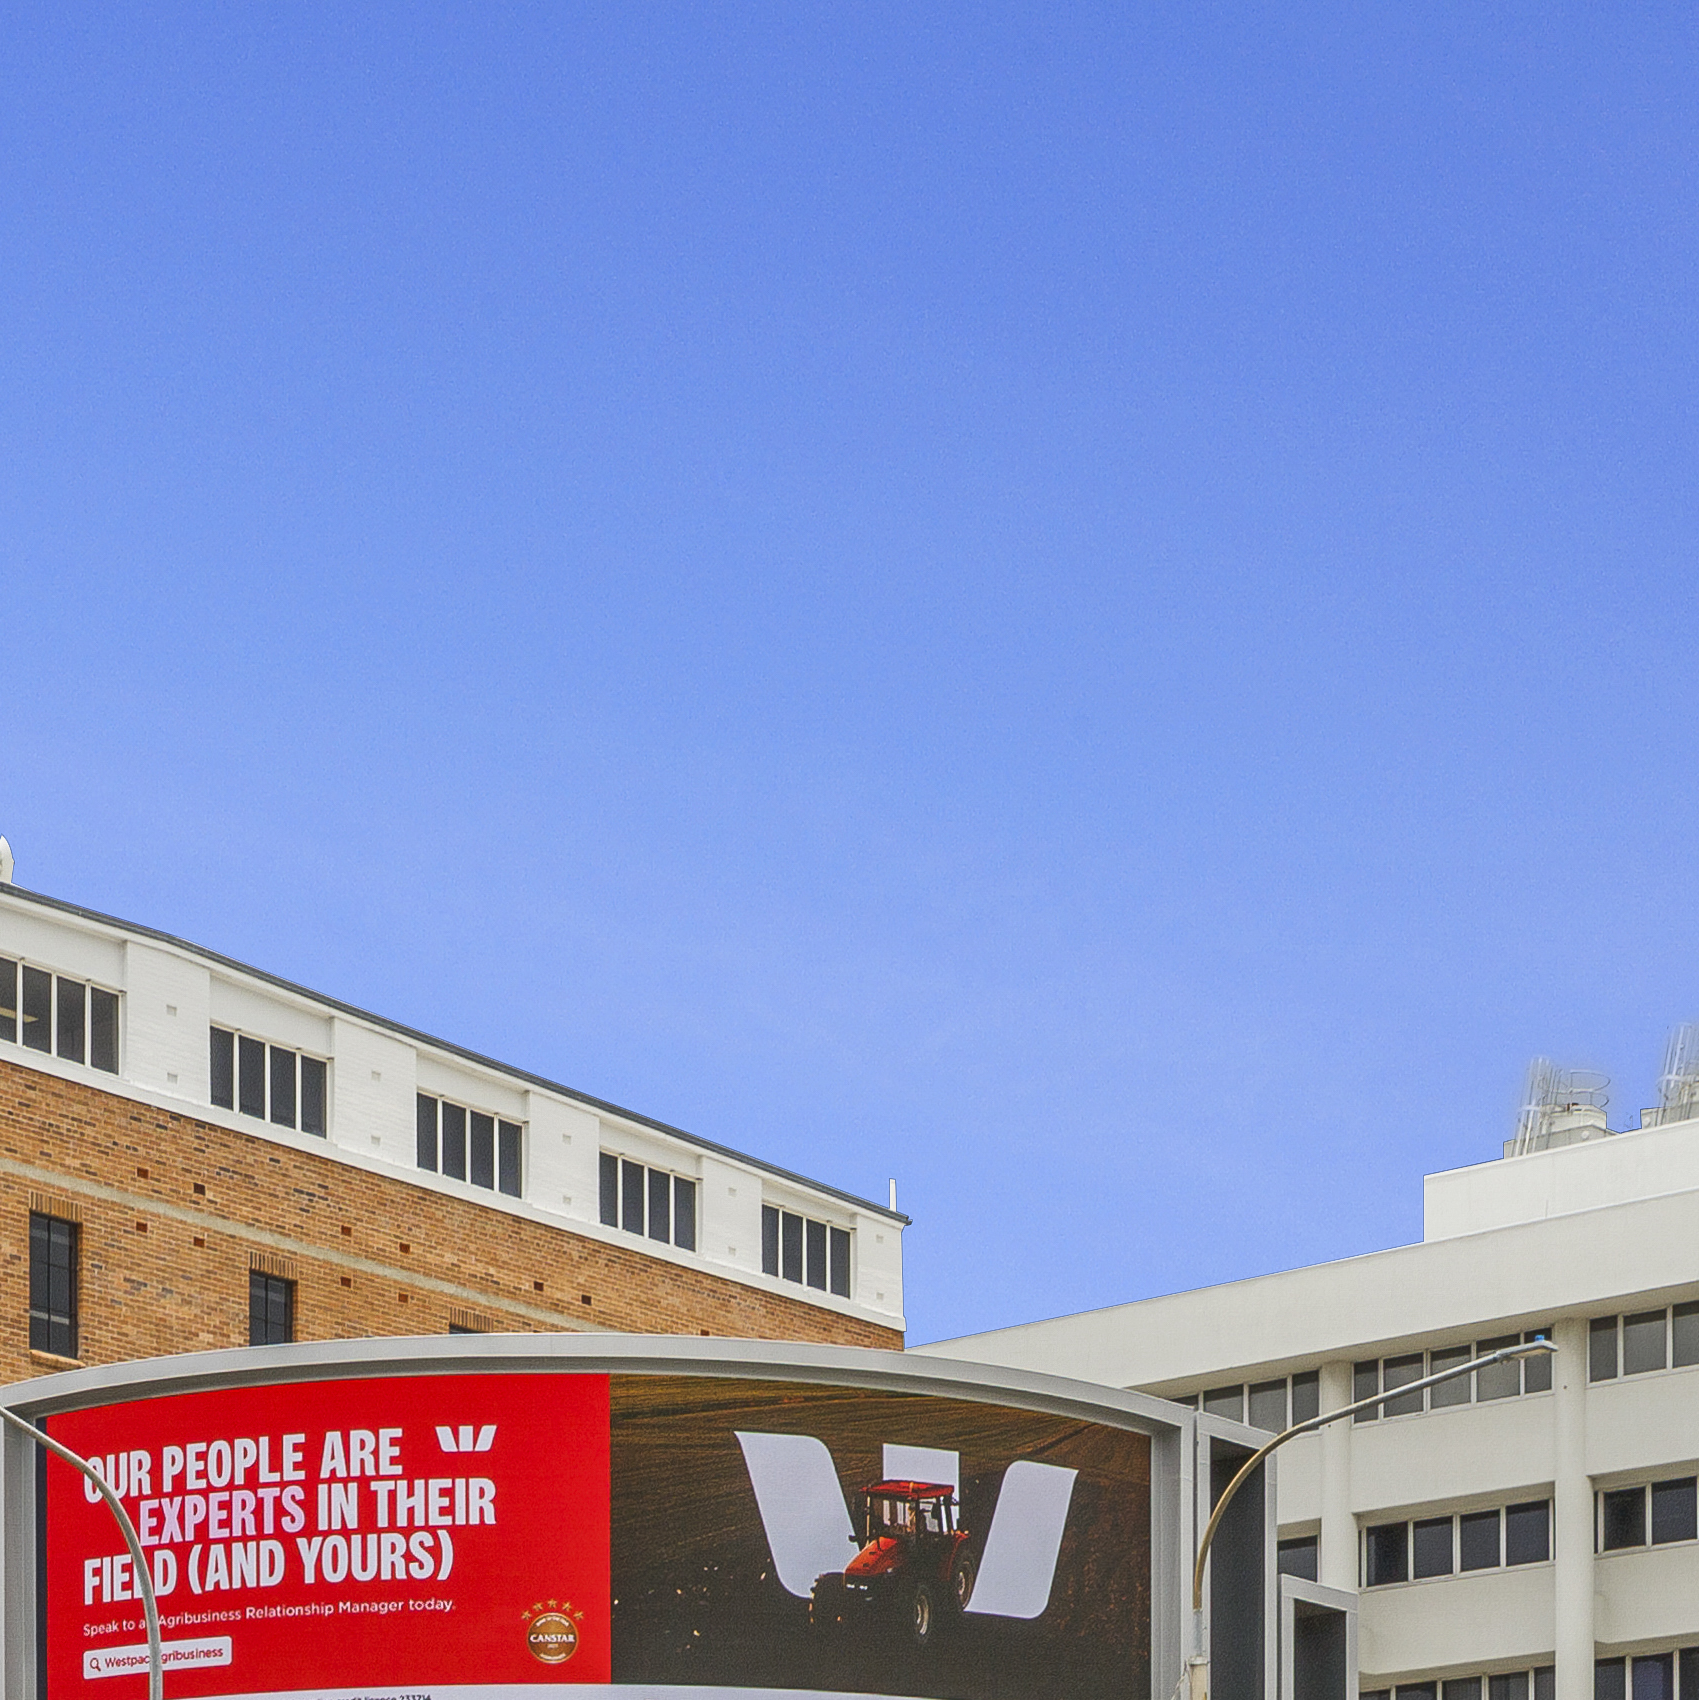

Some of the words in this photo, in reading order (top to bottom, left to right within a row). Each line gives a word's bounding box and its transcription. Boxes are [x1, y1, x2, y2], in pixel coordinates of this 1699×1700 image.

[84, 1450, 151, 1503] OUR
[162, 1433, 306, 1490] PEOPLE
[320, 1428, 403, 1479] ARE
[139, 1485, 305, 1547] EXPERTS
[318, 1483, 359, 1531] IN
[370, 1478, 497, 1528] THEIR
[188, 1540, 285, 1594] (AND
[296, 1530, 454, 1584] YOURS)
[83, 1620, 119, 1637] Speak
[123, 1619, 136, 1629] to
[158, 1610, 241, 1629] Agribusiness
[245, 1602, 334, 1619] Relationship
[338, 1600, 404, 1615] Manager
[408, 1597, 457, 1613] today.
[530, 1633, 575, 1643] CANSTAR
[105, 1655, 150, 1669] Westpac
[161, 1647, 223, 1664] gribusiness
